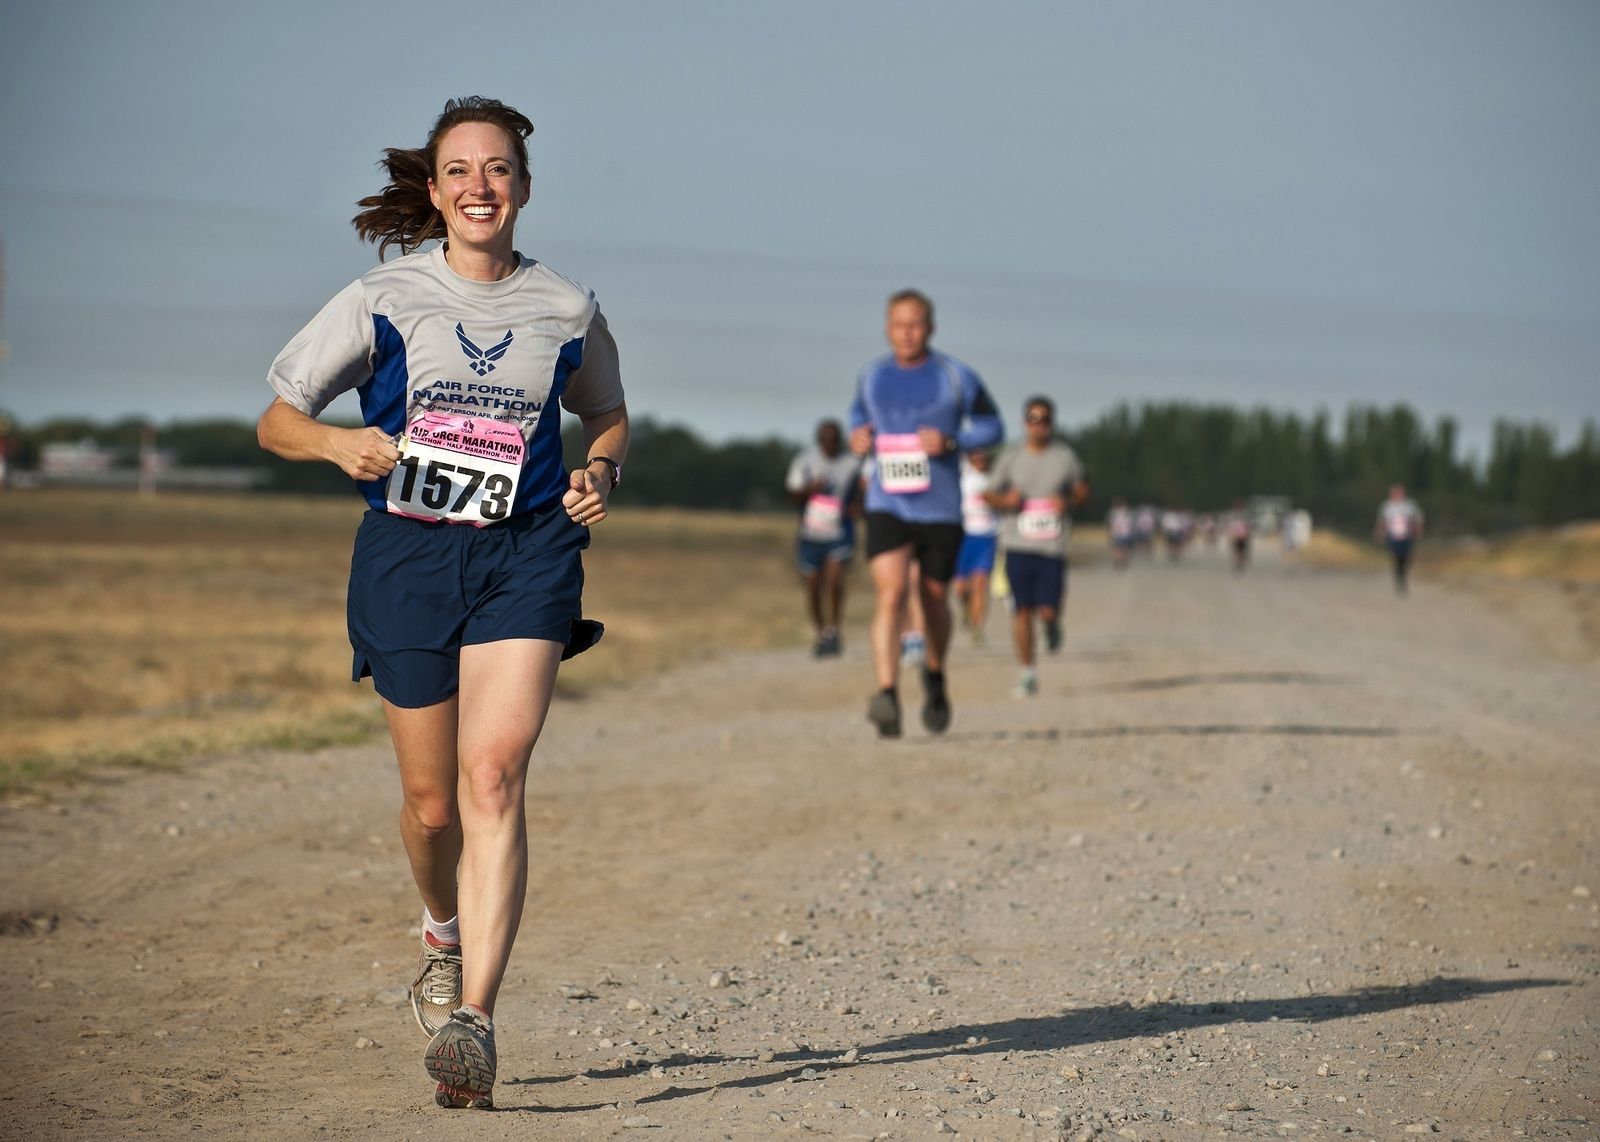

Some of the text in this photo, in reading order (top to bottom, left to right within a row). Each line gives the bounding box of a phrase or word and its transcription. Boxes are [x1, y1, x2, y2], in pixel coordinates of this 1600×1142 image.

[432, 380, 526, 398] AIR FORCE
[412, 390, 542, 412] MARATHON
[410, 436, 442, 445] MATHON
[464, 446, 500, 457] MARATHON
[411, 426, 522, 455] AIR ORCE MARATHON
[400, 455, 513, 520] 1573
